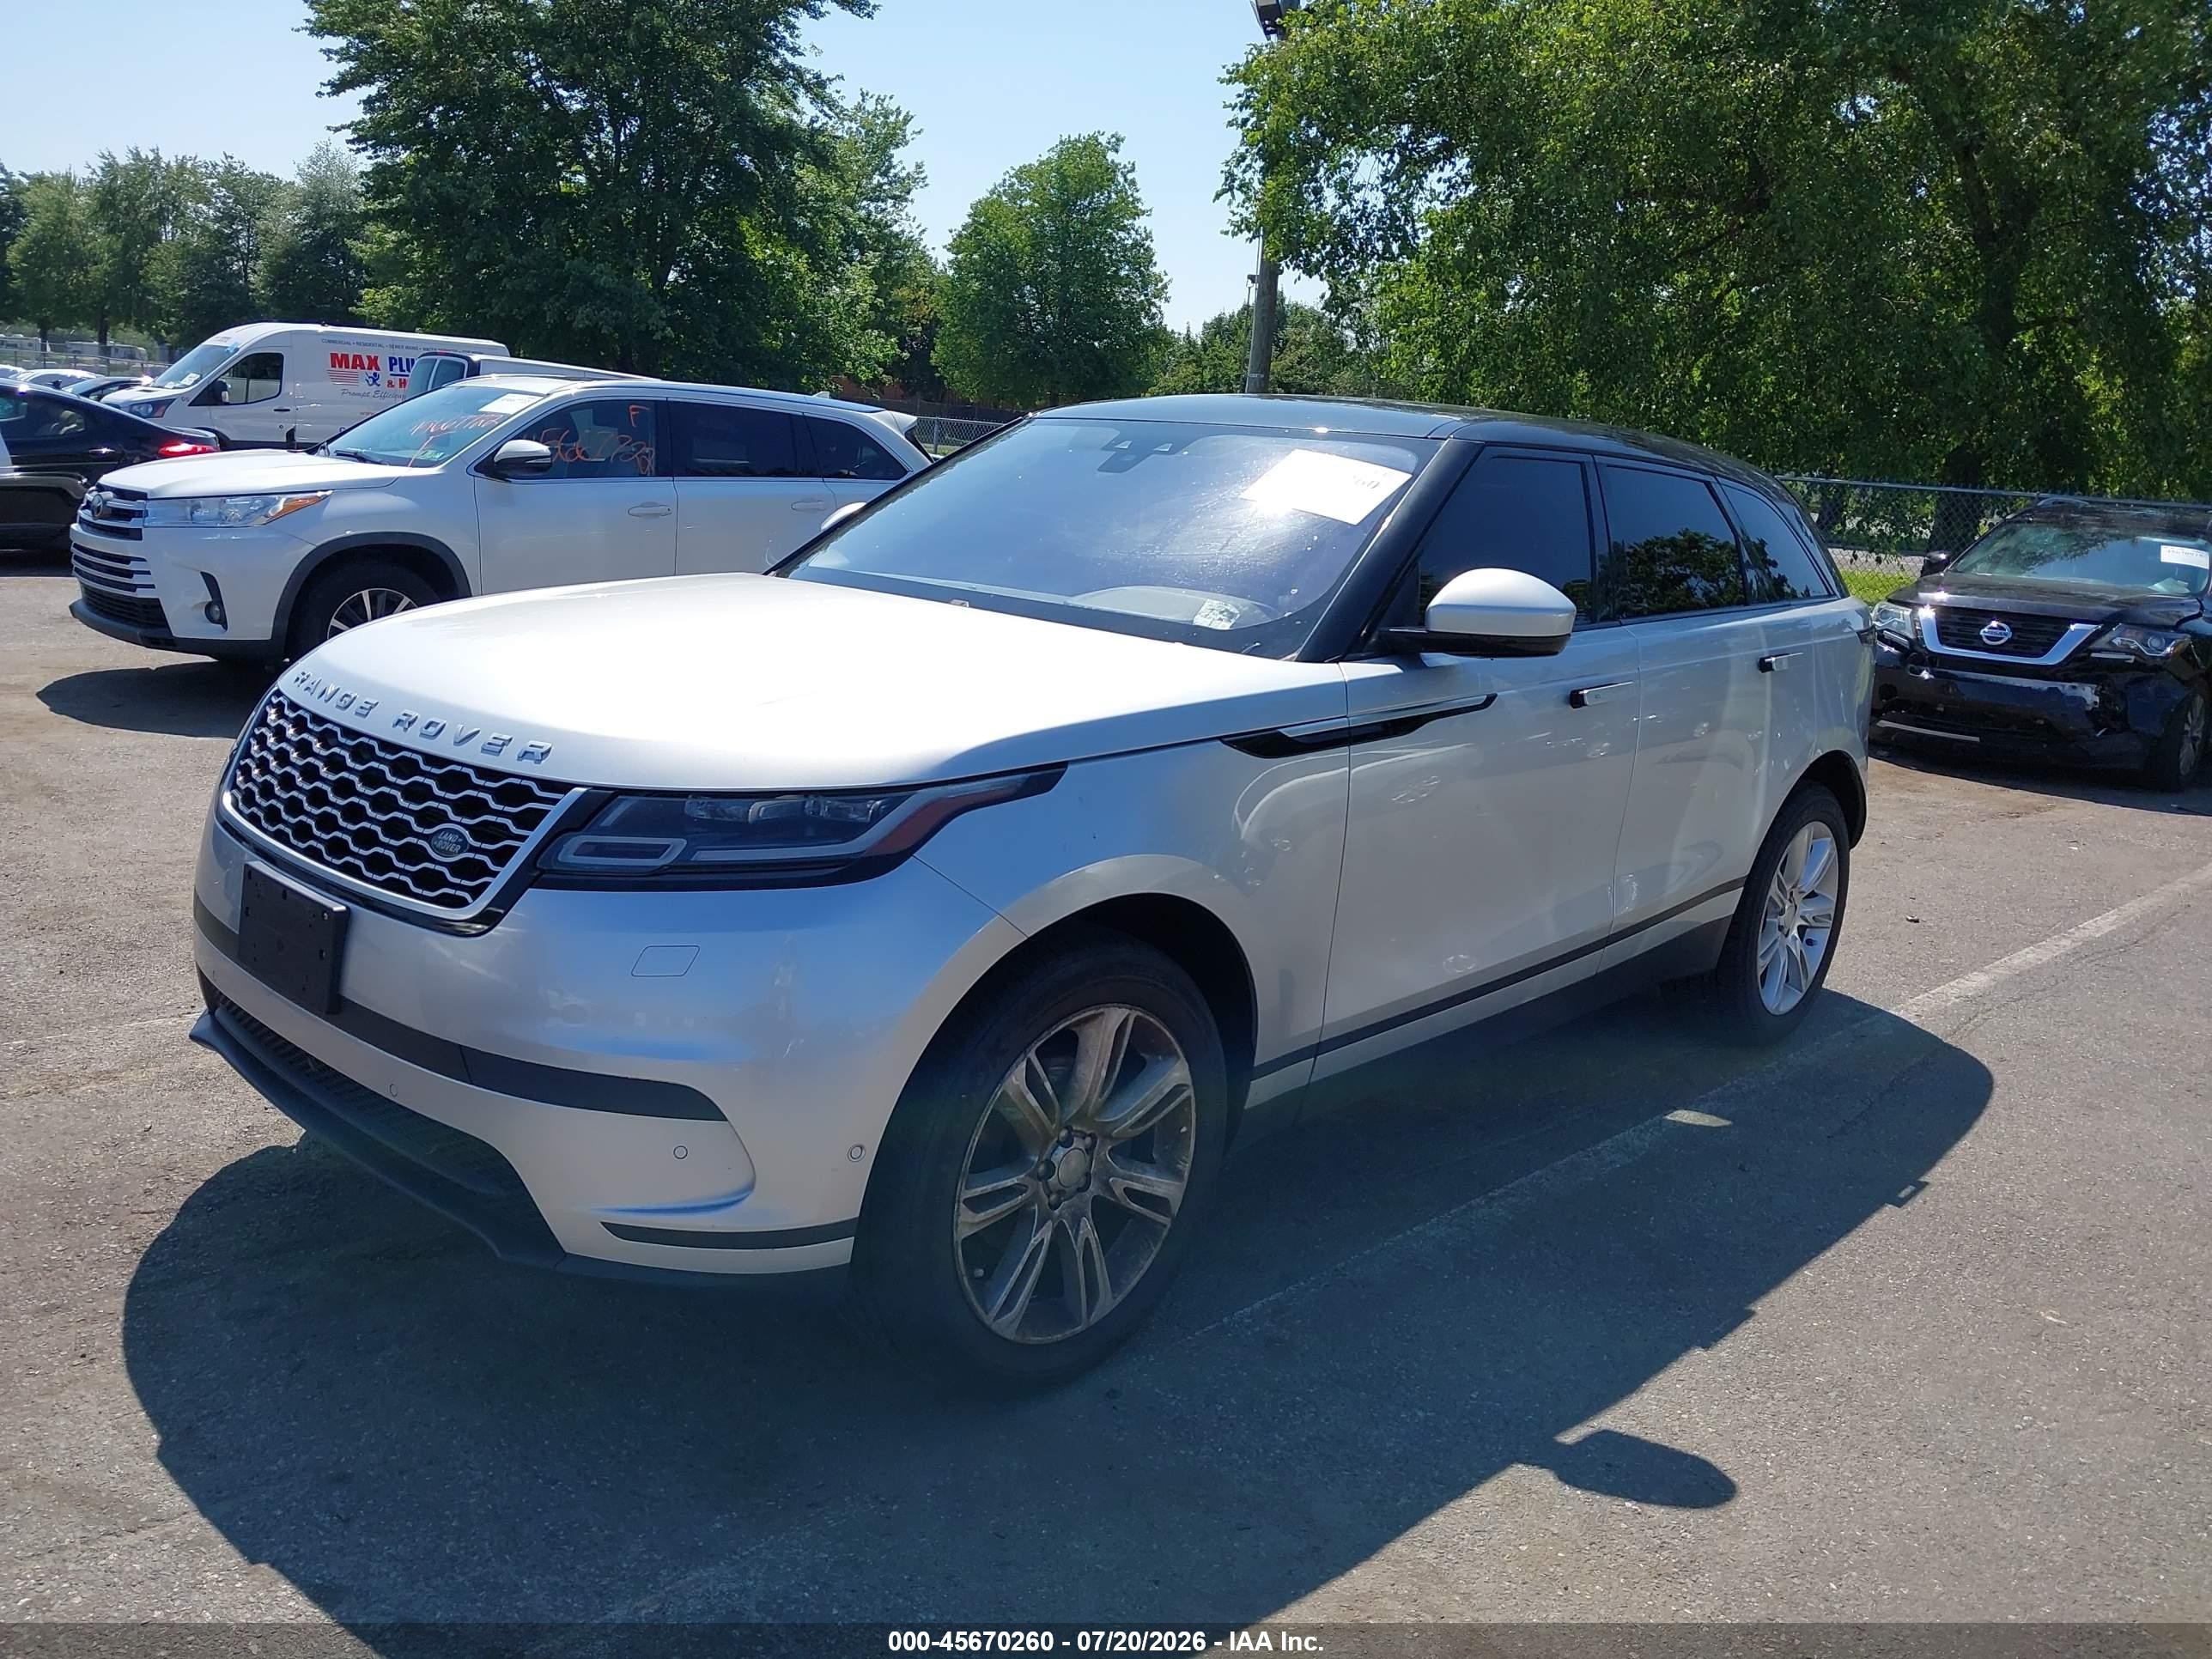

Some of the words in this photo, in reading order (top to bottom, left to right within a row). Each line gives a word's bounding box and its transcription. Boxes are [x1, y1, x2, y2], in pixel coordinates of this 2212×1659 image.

[330, 352, 380, 371] MAX
[386, 380, 395, 388] &
[341, 388, 371, 399] Prompt
[628, 404, 650, 428] F
[294, 671, 380, 719] RANGE
[392, 708, 554, 764] ROVER
[439, 831, 459, 842] LAND
[435, 840, 461, 854] ROVER
